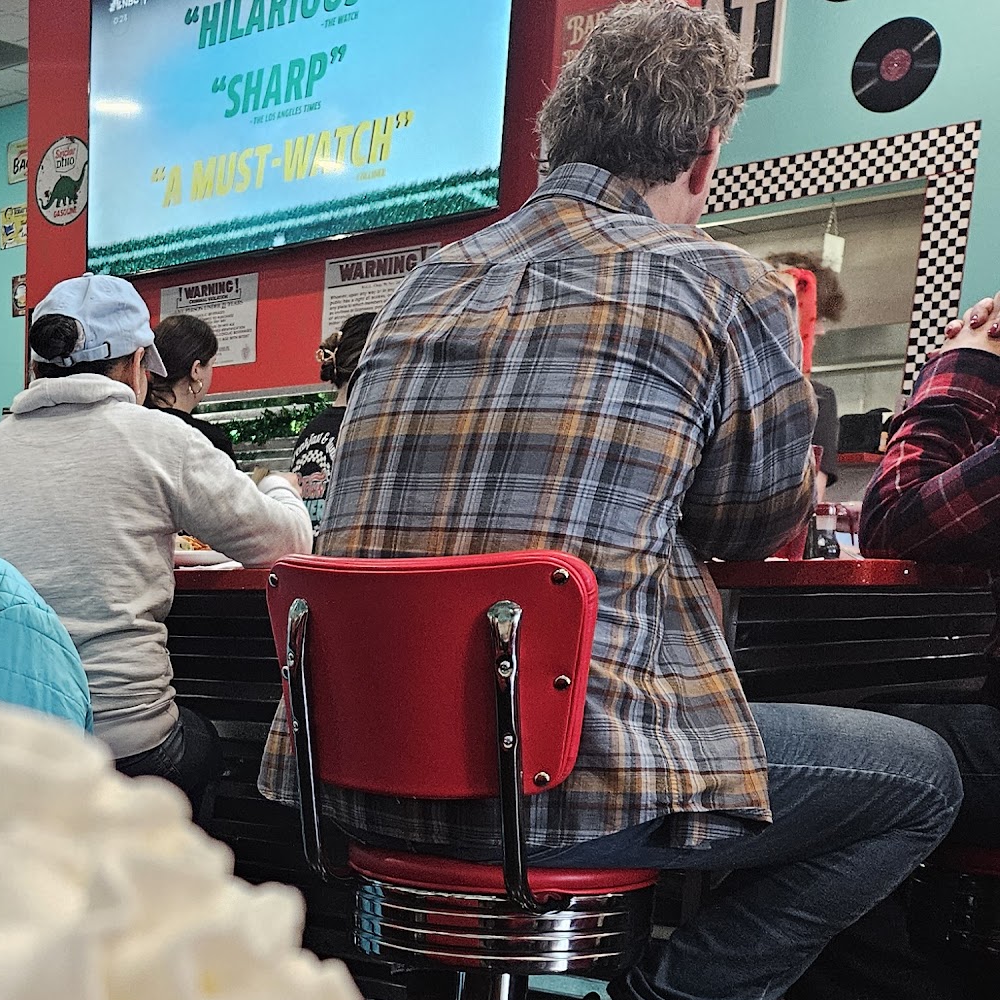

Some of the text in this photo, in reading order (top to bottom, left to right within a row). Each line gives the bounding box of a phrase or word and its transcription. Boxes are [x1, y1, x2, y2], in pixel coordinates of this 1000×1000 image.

[184, 0, 359, 49] “HILARI
[337, 11, 359, 25] WATCH
[211, 44, 347, 118] “SHARP”
[265, 113, 276, 122] LOS
[276, 106, 302, 120] ANGELES
[303, 101, 322, 113] TIMES
[56, 157, 75, 168] DINO
